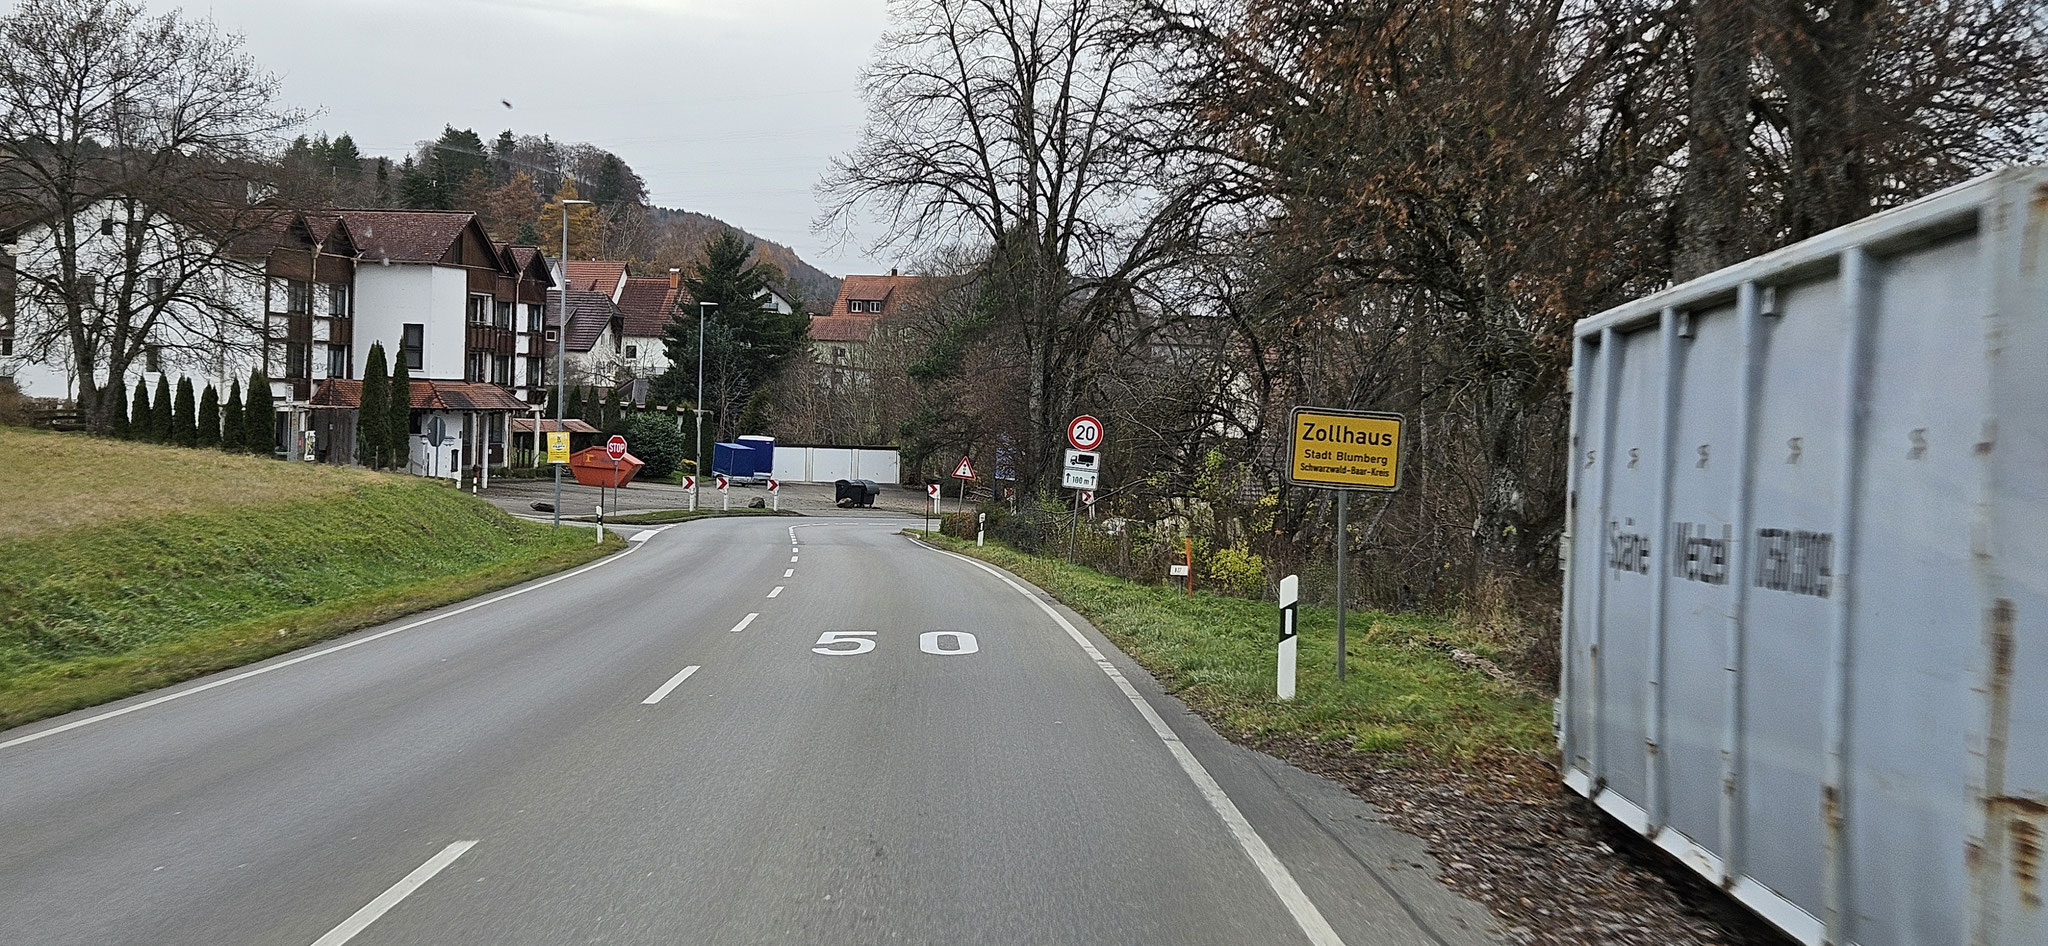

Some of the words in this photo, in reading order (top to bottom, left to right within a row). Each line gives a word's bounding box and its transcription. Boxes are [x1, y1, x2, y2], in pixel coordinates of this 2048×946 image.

[1075, 425, 1095, 441] 20
[1302, 422, 1392, 446] Zollhaus
[609, 442, 625, 453] STOP
[1304, 449, 1332, 460] Stadt
[1336, 451, 1388, 467] Blumberg
[1300, 462, 1390, 477] Schwarzwald-Baar-Kreis
[1072, 475, 1083, 484] 100
